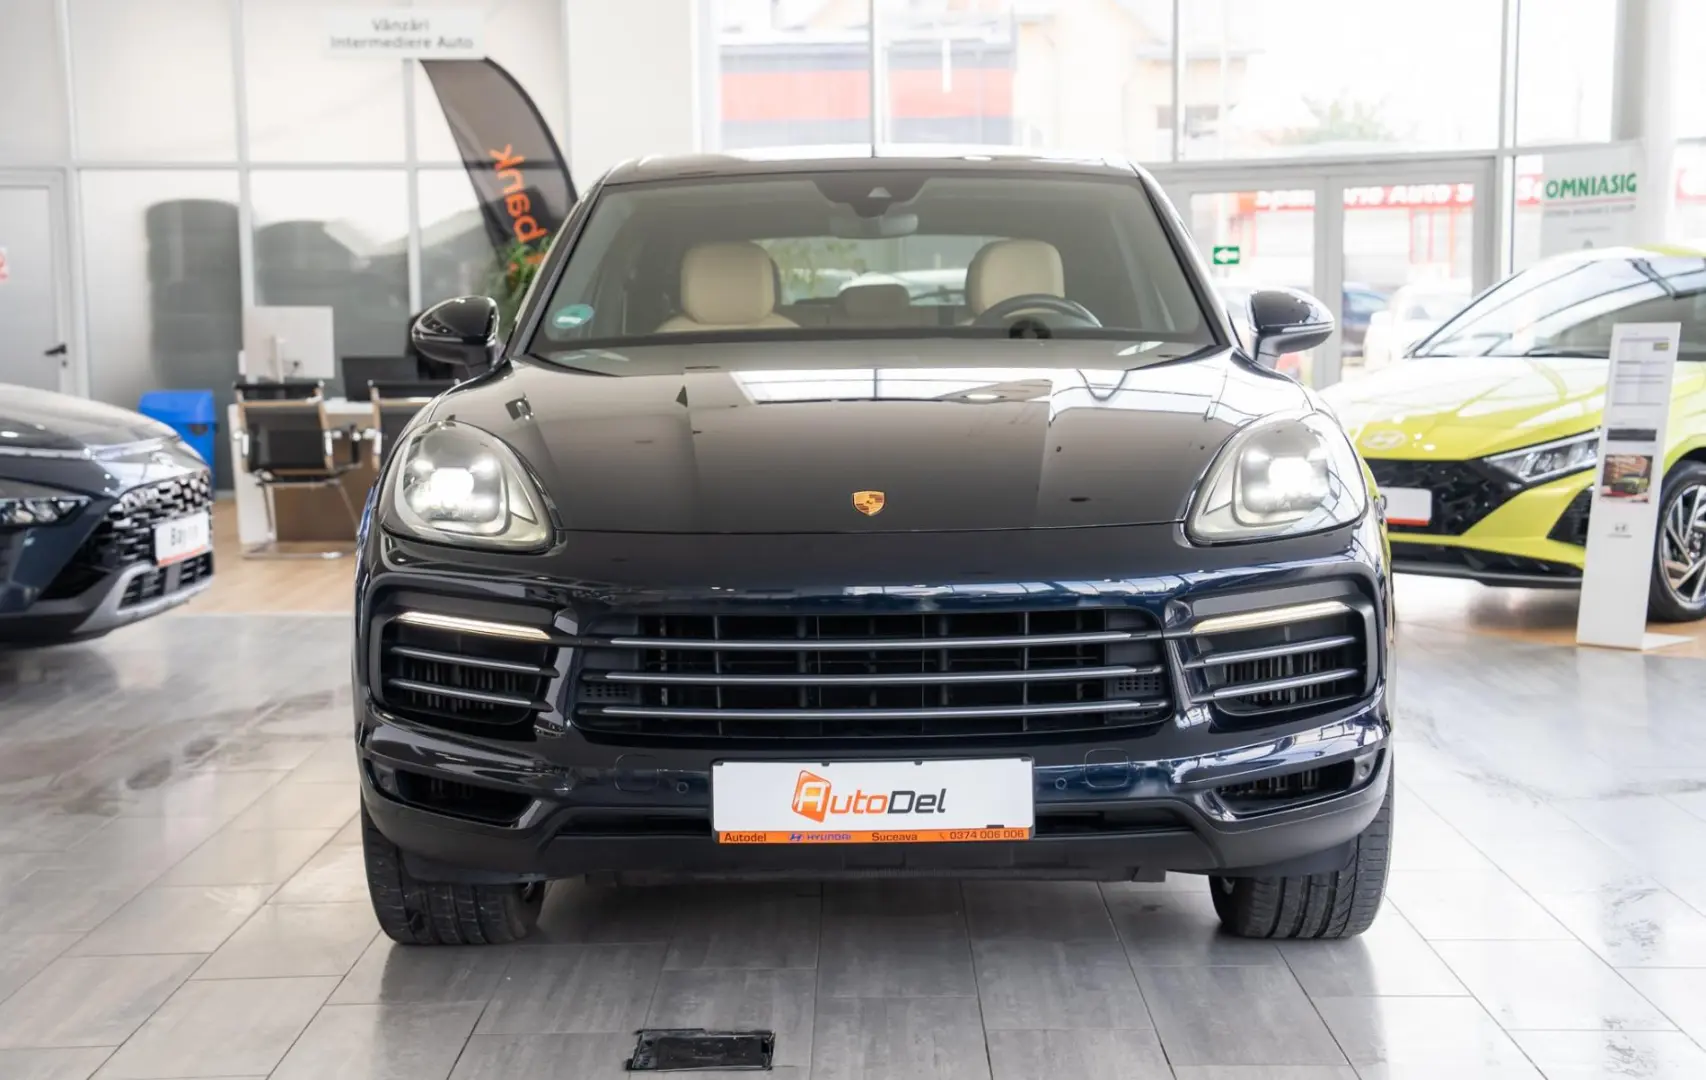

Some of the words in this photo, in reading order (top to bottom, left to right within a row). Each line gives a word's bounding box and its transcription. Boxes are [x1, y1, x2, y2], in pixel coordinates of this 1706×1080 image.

[330, 36, 432, 49] Intermediere
[437, 36, 474, 49] Auto
[1545, 172, 1637, 199] OMNIASIG
[795, 779, 947, 816] AutoDel
[724, 832, 767, 842] Autodel
[871, 832, 918, 841] Suceava
[950, 831, 977, 840] 0374
[980, 830, 1001, 839] 006
[1003, 830, 1025, 838] 006
